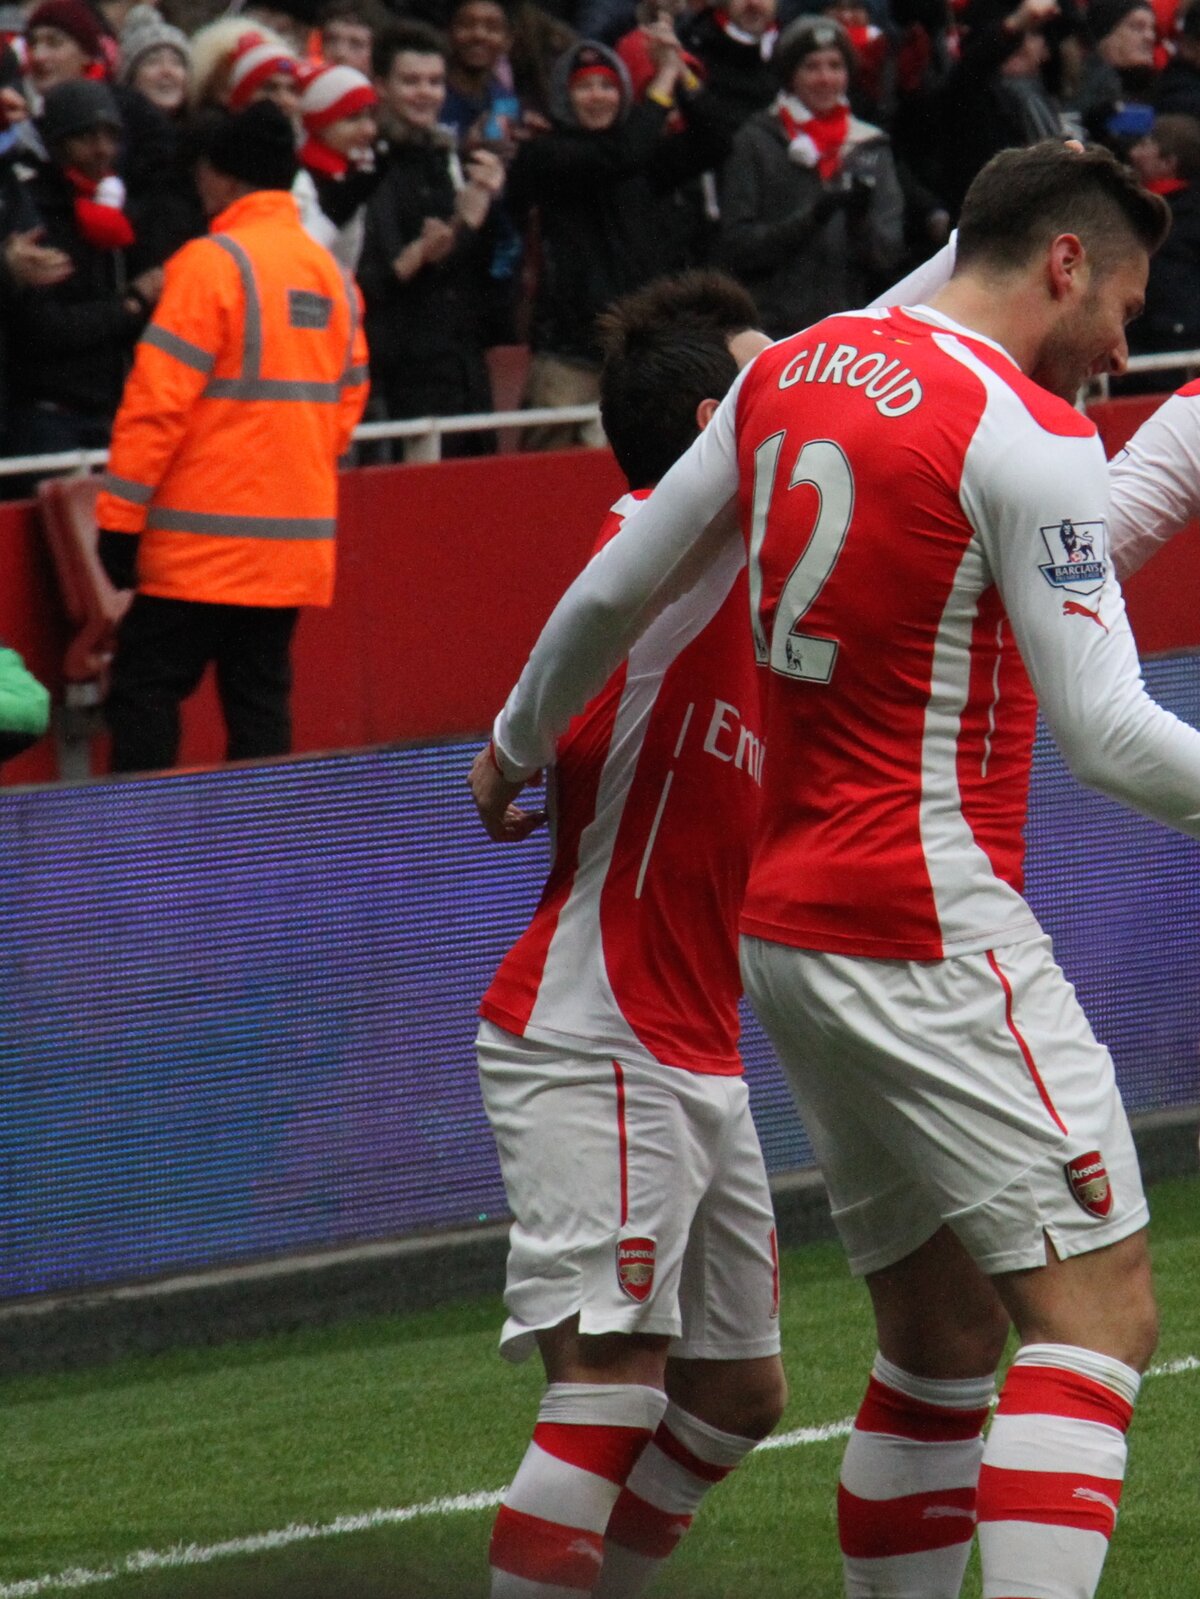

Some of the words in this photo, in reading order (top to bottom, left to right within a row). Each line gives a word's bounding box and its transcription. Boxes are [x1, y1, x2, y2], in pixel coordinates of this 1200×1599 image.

[778, 343, 924, 418] GIROUD
[748, 429, 856, 685] 12
[1055, 564, 1100, 577] BARCLAYS
